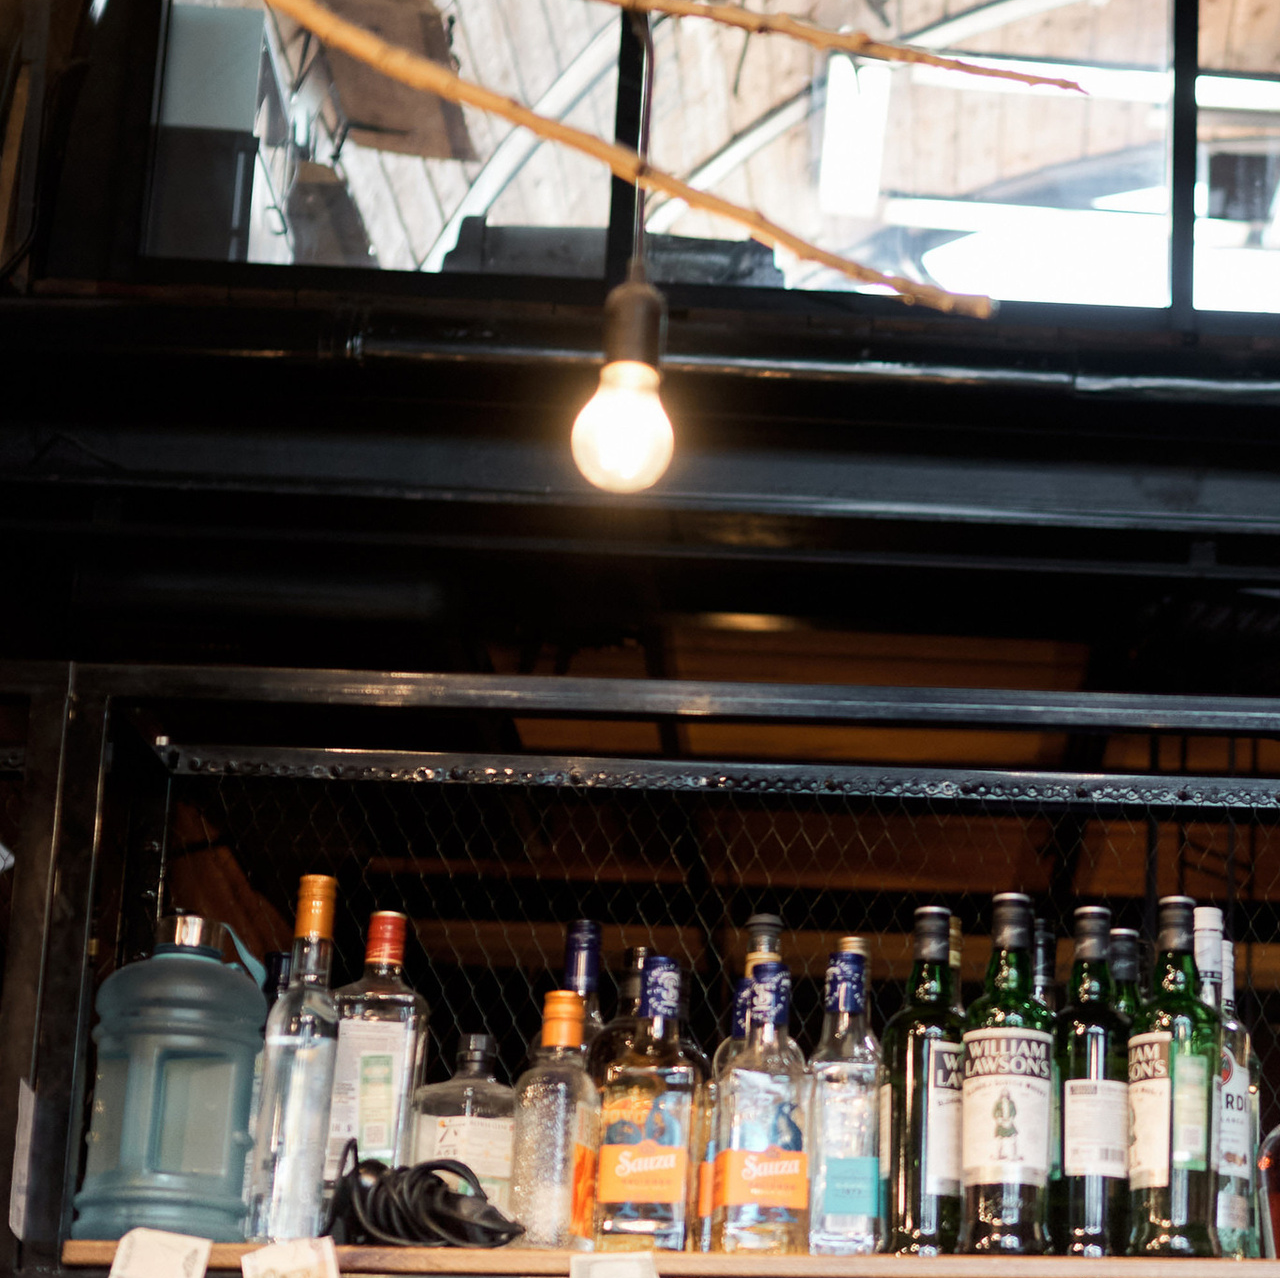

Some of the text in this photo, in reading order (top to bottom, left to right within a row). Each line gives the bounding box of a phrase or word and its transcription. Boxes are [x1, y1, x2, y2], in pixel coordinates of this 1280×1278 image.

[968, 1038, 1047, 1060] WILLIAM
[1129, 1042, 1160, 1065] IAM
[965, 1055, 1050, 1078] LAWSON'S
[615, 1149, 677, 1177] Sauza
[741, 1154, 801, 1181] Sauza
